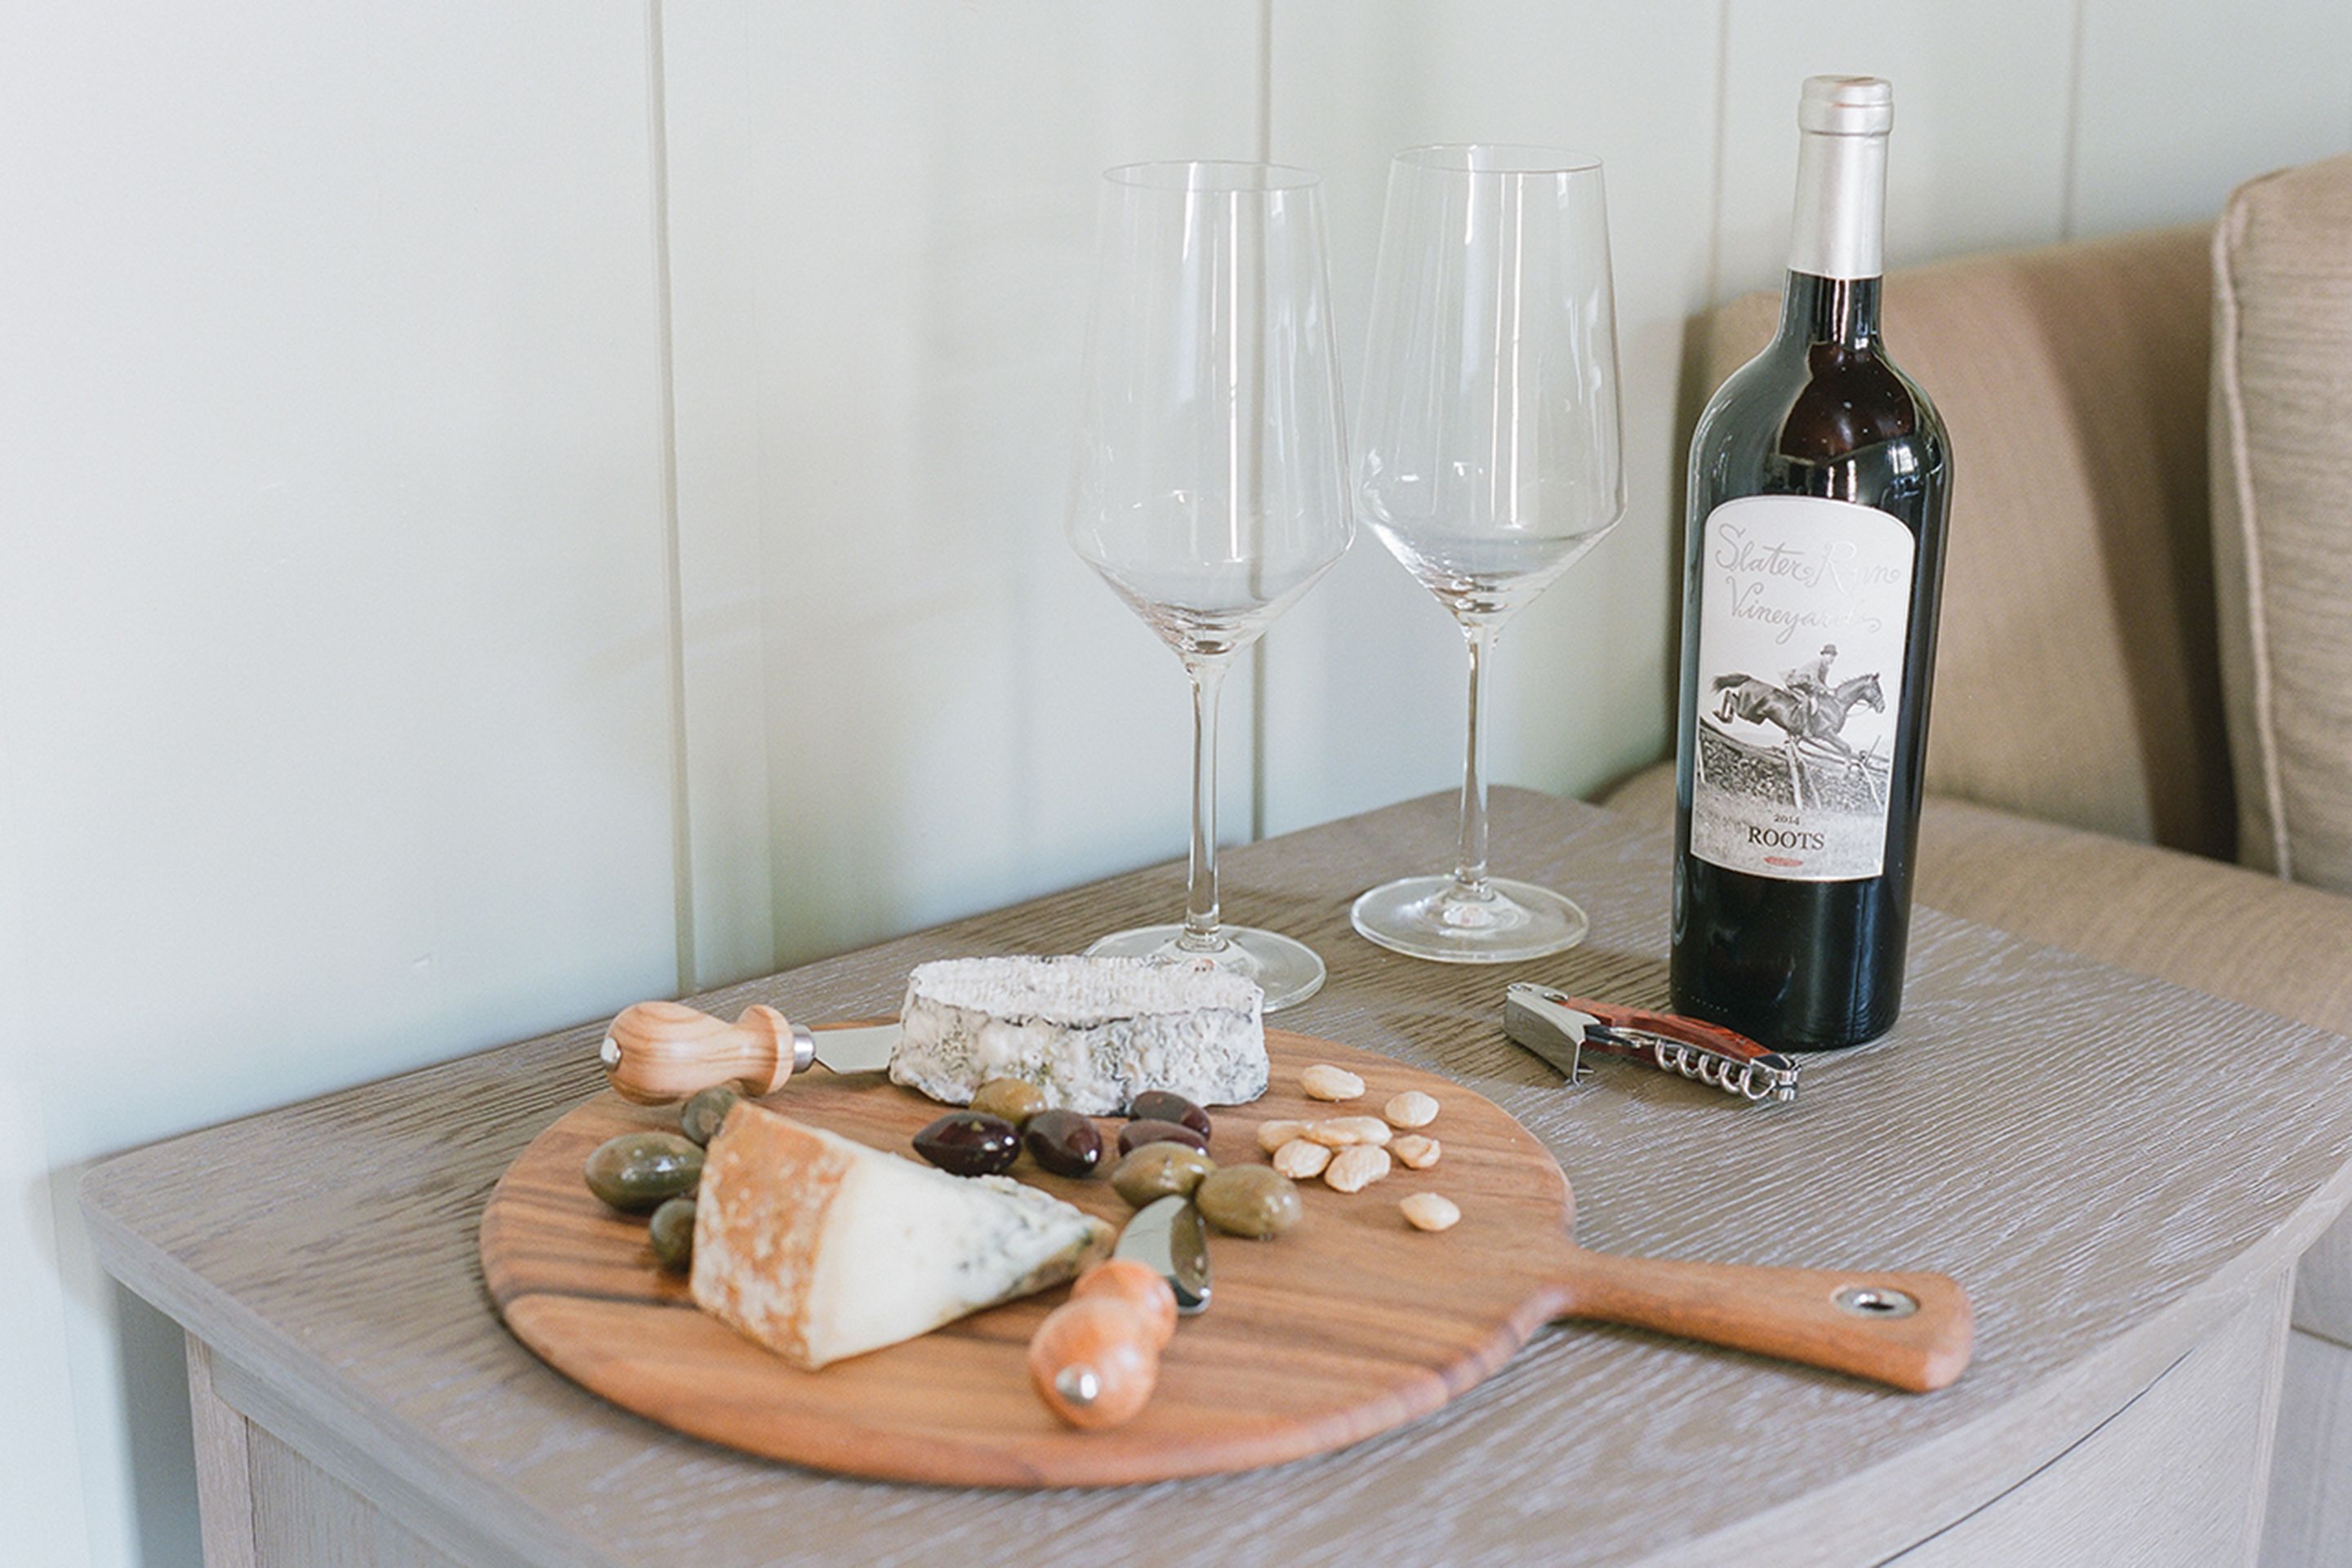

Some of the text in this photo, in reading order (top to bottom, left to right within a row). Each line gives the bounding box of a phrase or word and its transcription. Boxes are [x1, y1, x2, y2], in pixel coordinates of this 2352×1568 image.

[1714, 523, 1815, 581] Slater
[1725, 575, 1882, 645] Vineyars
[1748, 826, 1825, 850] ROOTS
[1773, 813, 1801, 825] 2014
